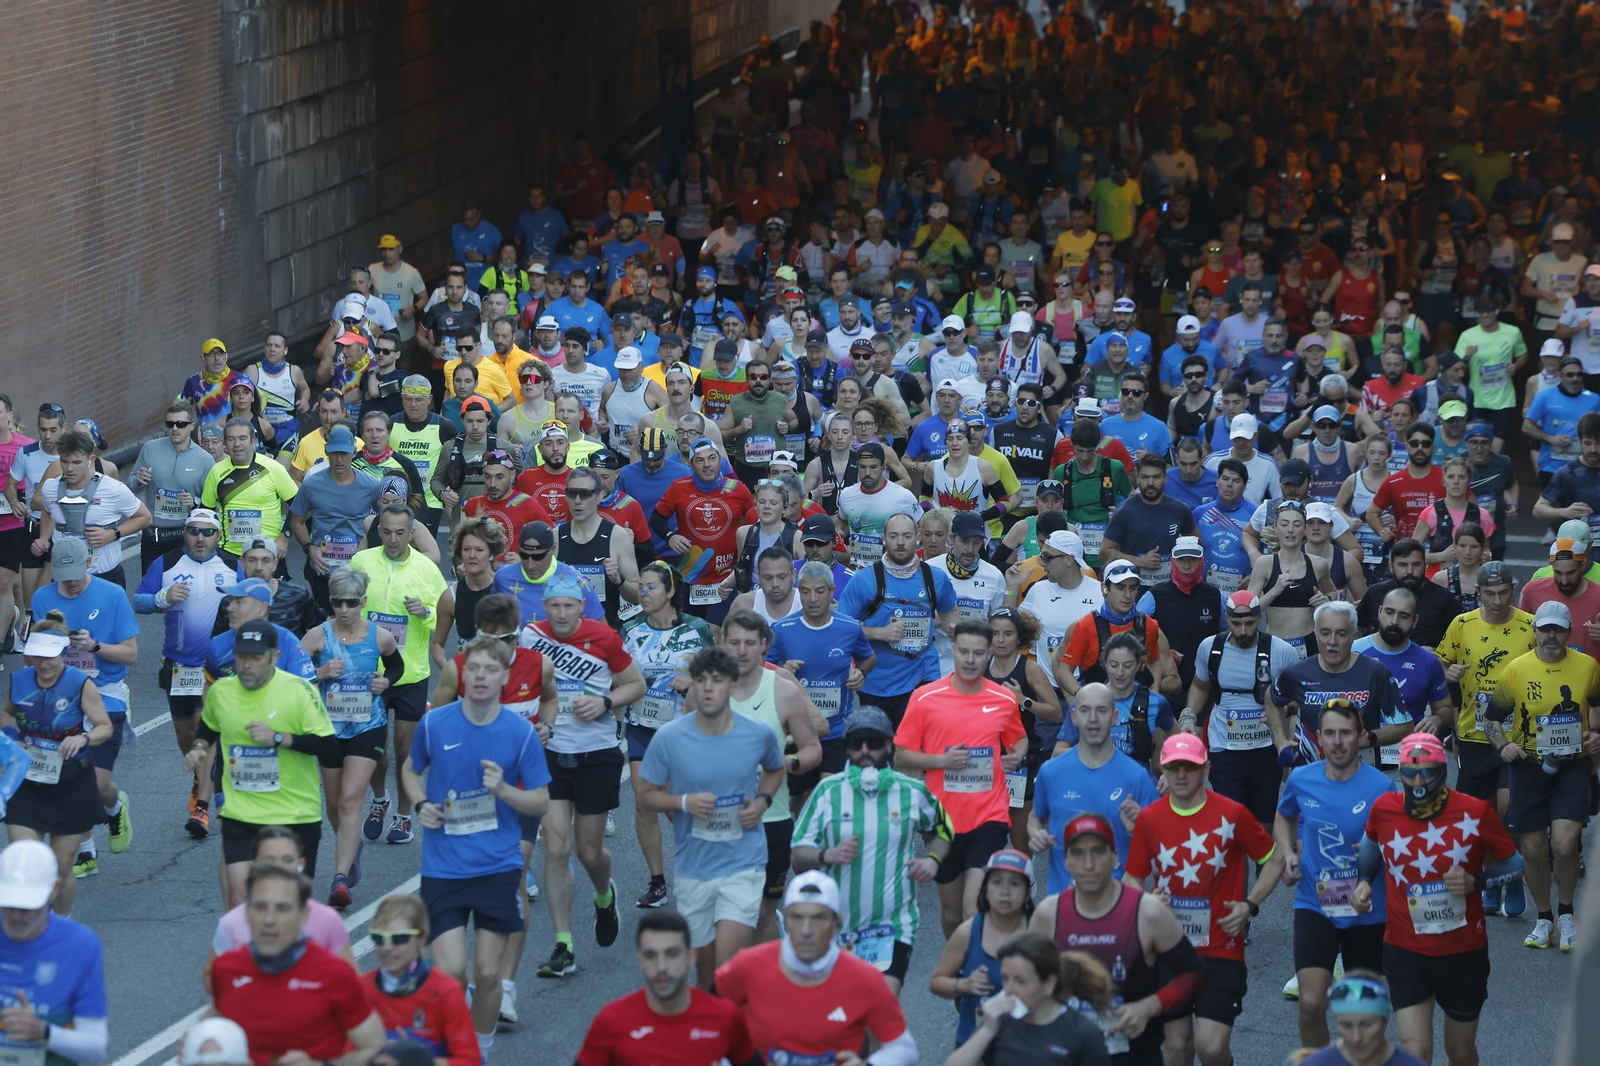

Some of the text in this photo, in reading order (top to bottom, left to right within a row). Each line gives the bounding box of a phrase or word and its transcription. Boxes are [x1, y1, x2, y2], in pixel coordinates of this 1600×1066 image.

[398, 441, 431, 450] RIMINI
[160, 505, 183, 514] JAVIER
[715, 552, 735, 563] RUN
[1218, 565, 1240, 573] ZURICH
[695, 589, 717, 597] OSCAR
[957, 600, 980, 608] ZURICH
[379, 614, 404, 623] ZURICH
[180, 678, 202, 687] ZURDI
[342, 684, 367, 692] ZURICH
[646, 689, 672, 699] ZURICH
[327, 705, 346, 714] MAMI
[352, 705, 371, 713] LELES
[643, 708, 658, 719] LUZ
[1551, 716, 1577, 724] ZURICH
[1227, 731, 1271, 741] BICYCLERIA
[1550, 736, 1570, 746] DOM
[243, 748, 272, 757] ZURICH
[944, 774, 993, 783] MAX BOWSKILL
[459, 788, 489, 799] ZURICH
[705, 820, 731, 831] JOSH
[1173, 900, 1205, 908] ZURICH
[1424, 907, 1455, 921] CRISS
[860, 926, 890, 938] ZURICH
